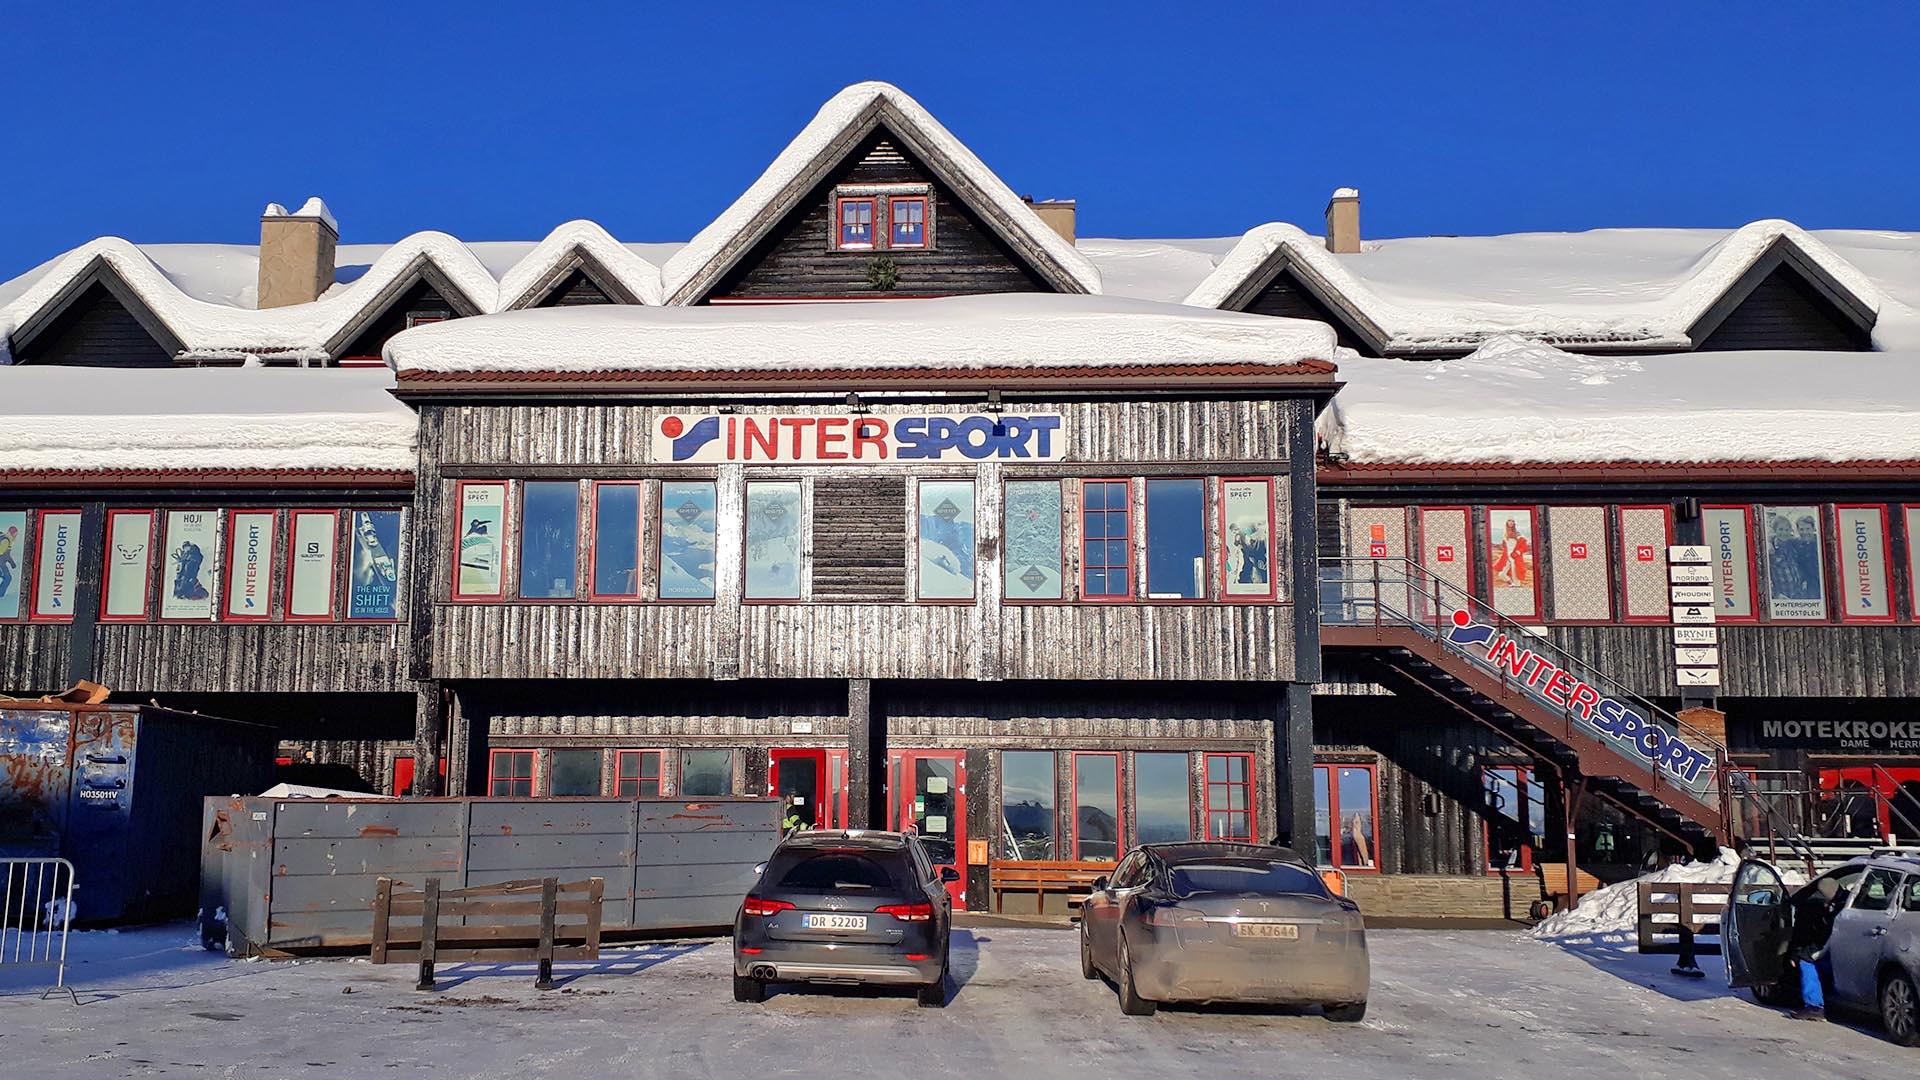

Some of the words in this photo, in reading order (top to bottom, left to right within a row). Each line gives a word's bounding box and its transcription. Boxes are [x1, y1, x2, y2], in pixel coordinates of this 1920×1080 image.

[726, 415, 1062, 461] INTERSPORT
[183, 514, 202, 523] HOJI
[54, 524, 68, 596] INTERSPORT
[245, 525, 259, 597] INTERSPORT
[1719, 520, 1734, 596] INTERSPORT
[1855, 520, 1871, 596] INTERSPORT
[355, 594, 390, 607] SHIFT
[1486, 633, 1713, 784] INTERSPORT
[1840, 739, 1869, 748] DAME
[811, 915, 826, 927] DR
[830, 916, 865, 928] 52203
[1240, 925, 1255, 936] EK
[1260, 925, 1295, 937] 47644
